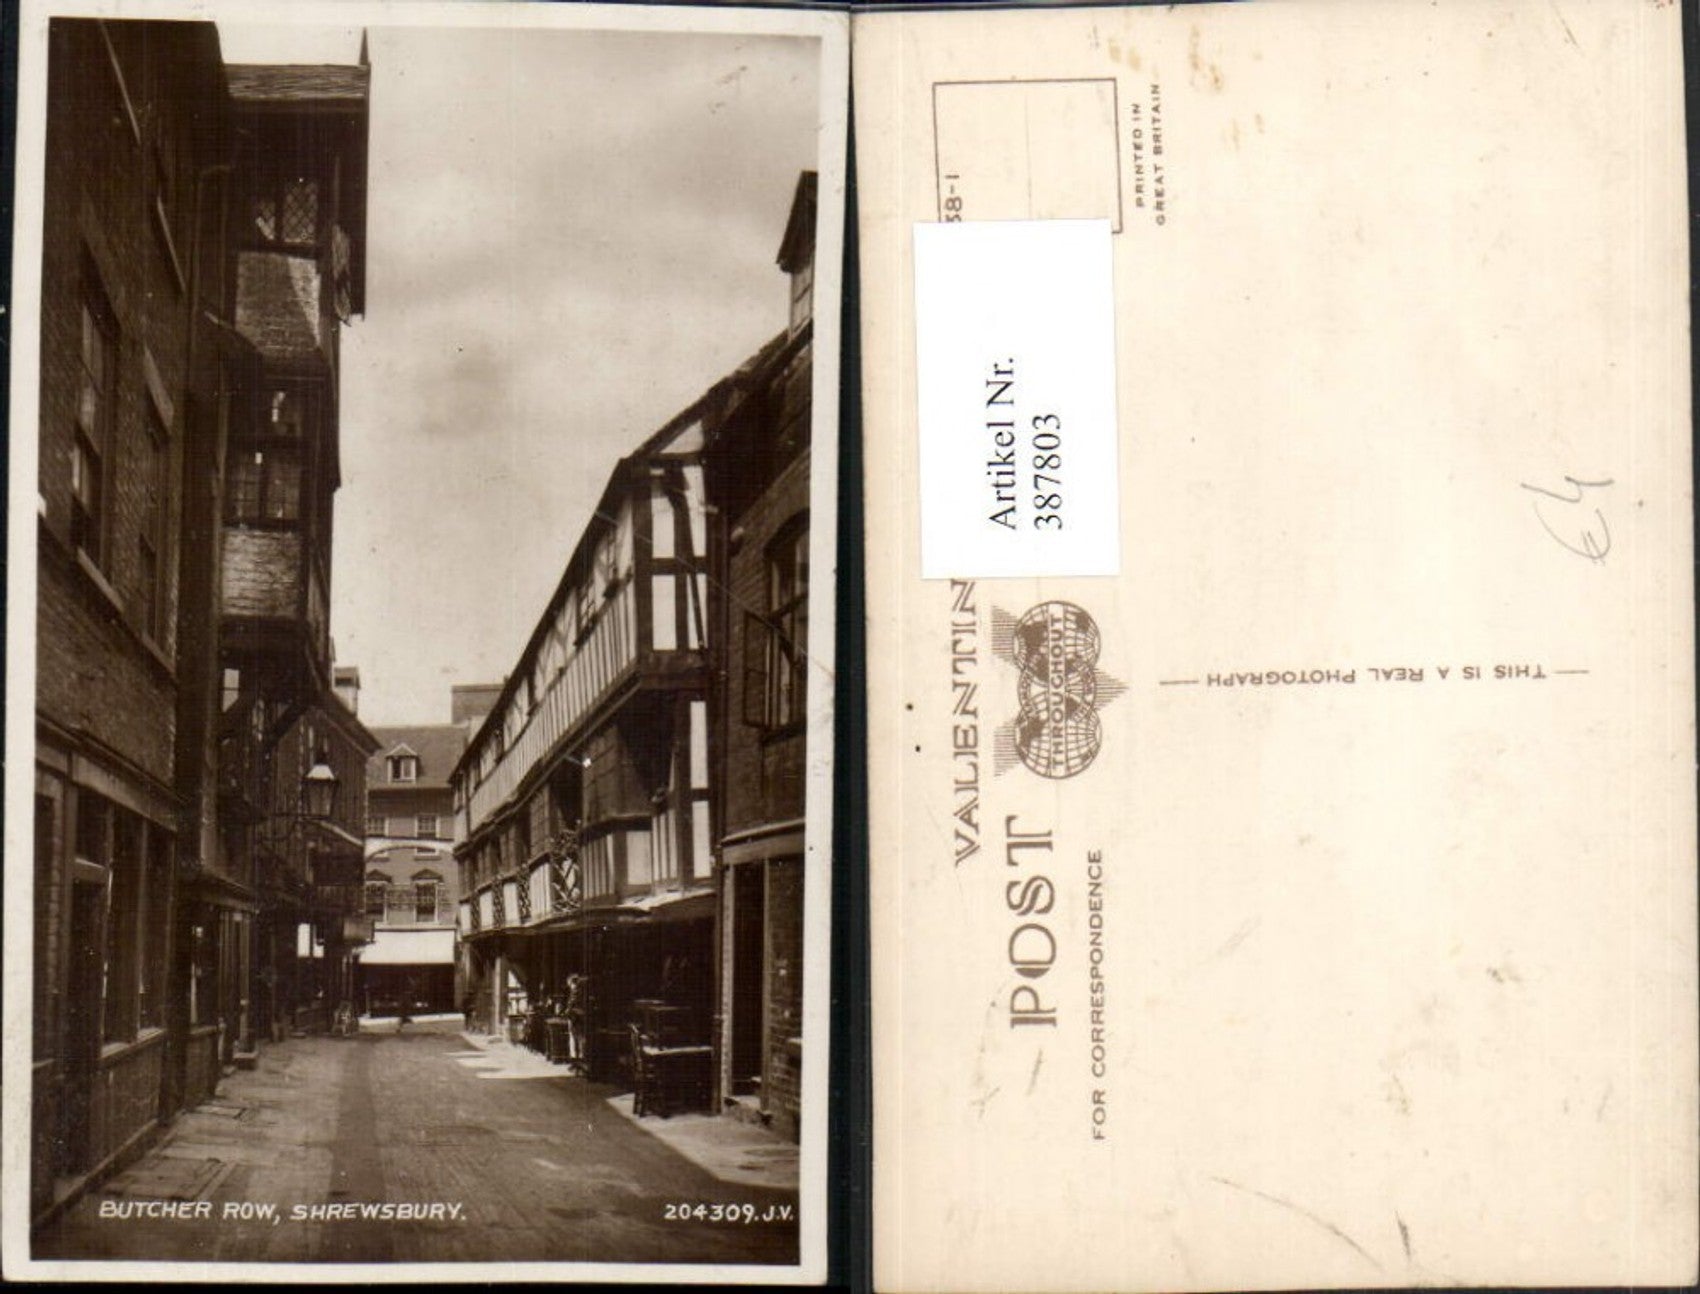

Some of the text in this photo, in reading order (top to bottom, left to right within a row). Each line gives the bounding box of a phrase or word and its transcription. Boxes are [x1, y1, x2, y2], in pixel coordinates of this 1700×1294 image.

[1131, 102, 1145, 208] PRINTED IN
[1150, 84, 1166, 226] GREAT BRITAIN
[986, 357, 1016, 530] Artikel Nr.
[1032, 414, 1062, 530] 387803
[1050, 614, 1064, 768] THROUGHOUT
[1207, 664, 1546, 687] THIS IS A REAL PHOTOGRAPH
[1006, 815, 1056, 1028] POST
[1088, 849, 1106, 1141] FOR CORRESPONDENCE
[99, 1200, 467, 1225] BUTCHER ROW, SHREWSBURY.
